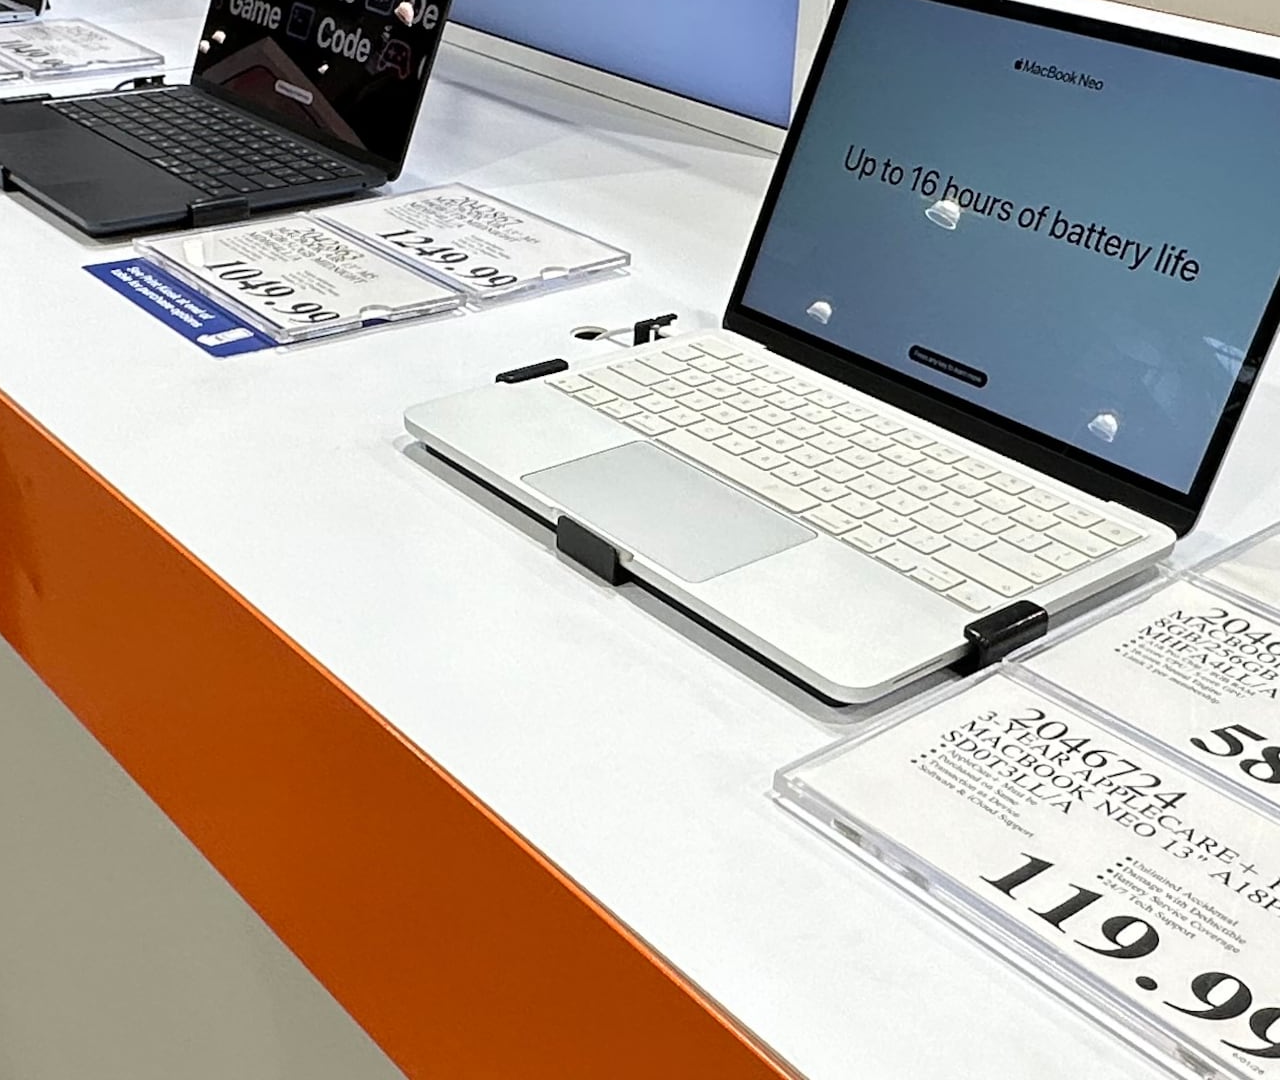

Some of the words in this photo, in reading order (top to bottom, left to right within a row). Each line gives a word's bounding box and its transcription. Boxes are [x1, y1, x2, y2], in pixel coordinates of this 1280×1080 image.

[317, 17, 371, 63] Code
[1022, 59, 1078, 85] MacBook
[1078, 73, 1104, 91] Neo
[843, 143, 876, 180] Up
[880, 156, 903, 185] to
[911, 165, 938, 196] 16
[941, 176, 1012, 221] hours
[1018, 205, 1050, 231] of
[1048, 209, 1153, 271] battery
[1156, 243, 1200, 284] life
[377, 229, 517, 287] 1249.99
[204, 260, 339, 323] 1049.99
[1139, 625, 1276, 698] MHFA4LL/A
[1154, 618, 1278, 680] 8GB/256GB
[929, 759, 976, 791] Transaction
[988, 796, 1019, 817] Device
[937, 754, 981, 781] Purchased
[981, 781, 993, 789] on
[994, 789, 1018, 805] Same
[948, 750, 998, 781] AppleCare+
[1001, 782, 1024, 797] Must
[1025, 796, 1037, 805] be
[961, 720, 1092, 801] MACBOOK
[1094, 800, 1155, 836] NEO
[1162, 840, 1207, 861] 13"
[1009, 709, 1186, 809] 2046724
[918, 764, 955, 788] Software
[967, 795, 998, 814] iCloud
[998, 814, 1033, 837] Support
[978, 712, 1069, 766] 3-YEAR
[1072, 769, 1257, 874] APPLECARE+
[1102, 879, 1128, 893] 24/7
[1129, 894, 1152, 912] Tech
[1155, 912, 1195, 938] Support
[1109, 872, 1147, 895] Battery
[1149, 896, 1187, 921] Service
[1190, 920, 1239, 953] Coverage
[1117, 866, 1162, 892] Damage
[1165, 893, 1187, 908] with
[1189, 907, 1246, 943] Deductible
[1132, 860, 1182, 891] Unlimited
[1182, 892, 1238, 926] Accidental
